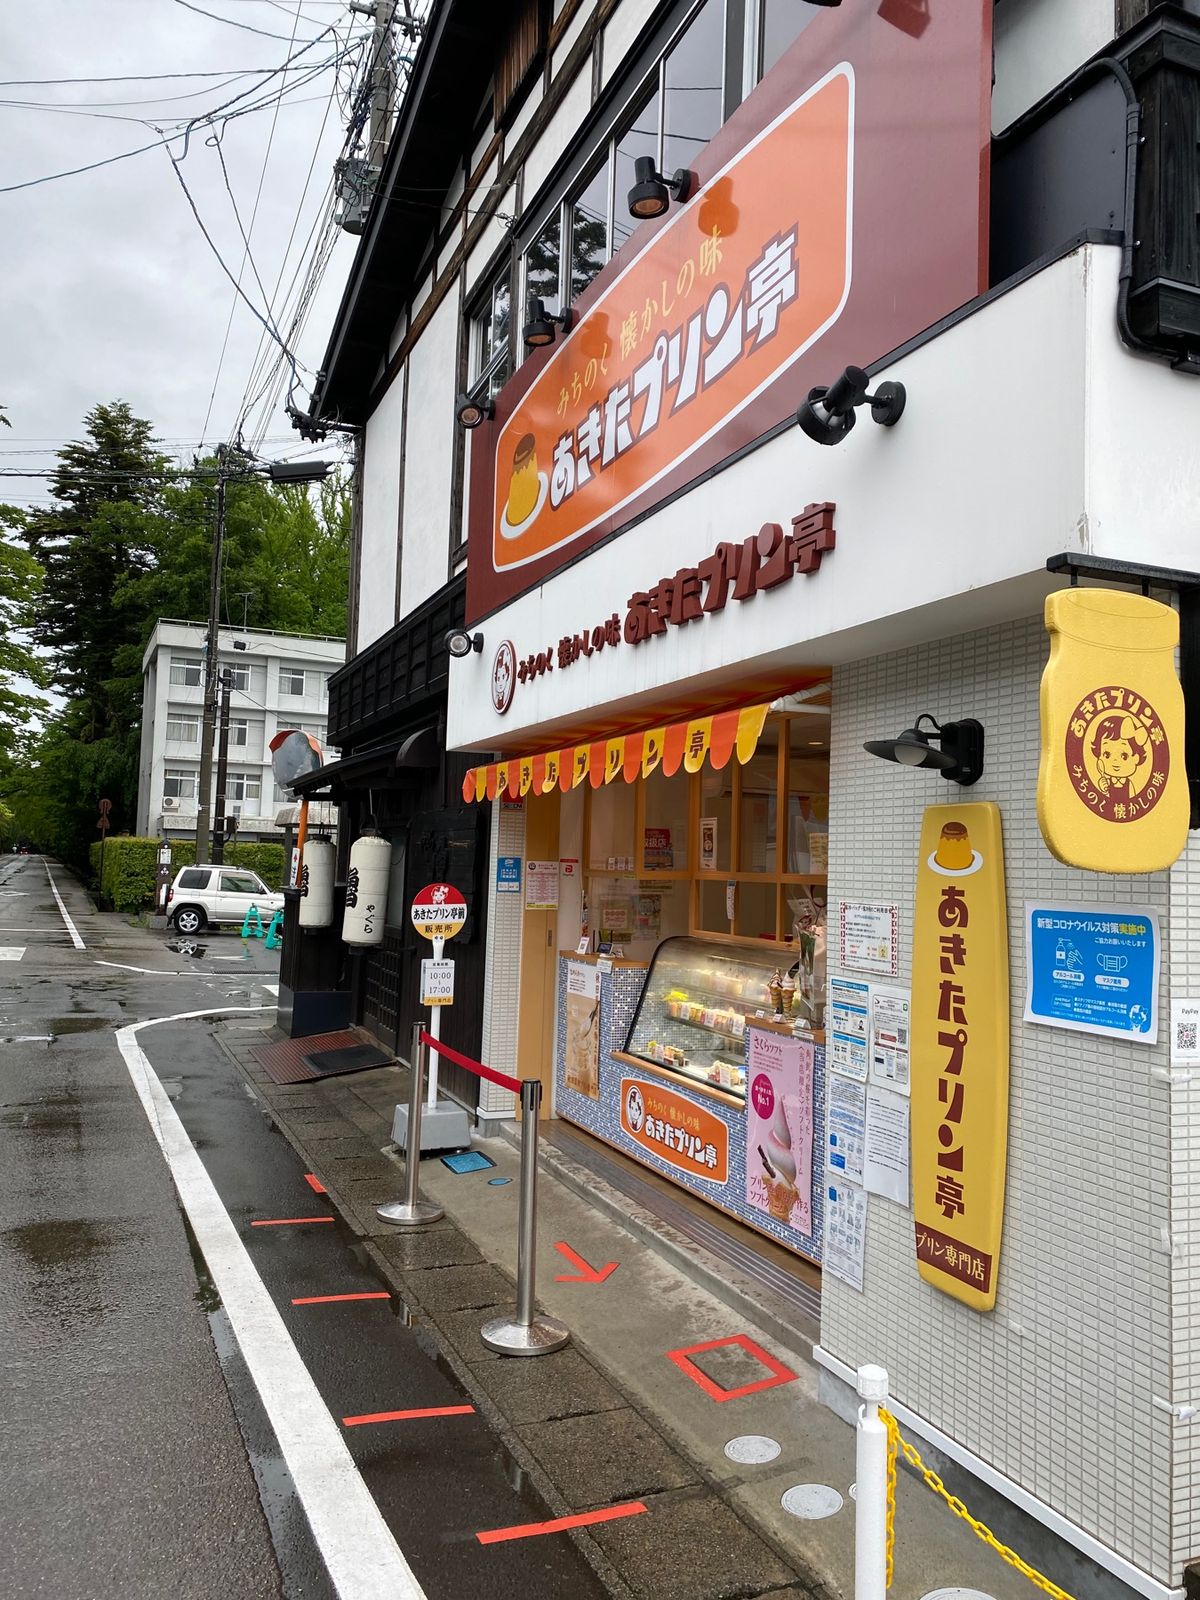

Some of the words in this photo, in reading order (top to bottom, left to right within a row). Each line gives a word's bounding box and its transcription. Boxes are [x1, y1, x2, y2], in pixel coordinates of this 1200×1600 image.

[556, 343, 609, 417] みちのく
[619, 224, 724, 361] 懐かしの味
[550, 228, 798, 509] あきたプリン亭
[517, 646, 553, 684] みちのく
[557, 613, 621, 669] 懐かしの味
[623, 502, 836, 645] あきたプリン亭
[1070, 689, 1164, 747] あきたプリン亭
[497, 729, 704, 791] あきたプリン亭
[1073, 764, 1106, 813] みちのく
[1113, 771, 1165, 819] 懐かしの味
[364, 904, 375, 934] やぐら
[413, 907, 465, 920] あきたプリン亭前
[424, 924, 453, 933] 販売所
[429, 986, 450, 994] 17:00
[430, 972, 451, 980] 10:00
[1181, 1008, 1199, 1016] PayPay
[754, 1036, 783, 1055] さくらソフト
[936, 886, 969, 1219] あきたプリン亭
[757, 1094, 770, 1106] No.1
[645, 1114, 717, 1169] あきたプリン亭
[916, 1232, 985, 1281] プリン専門店
